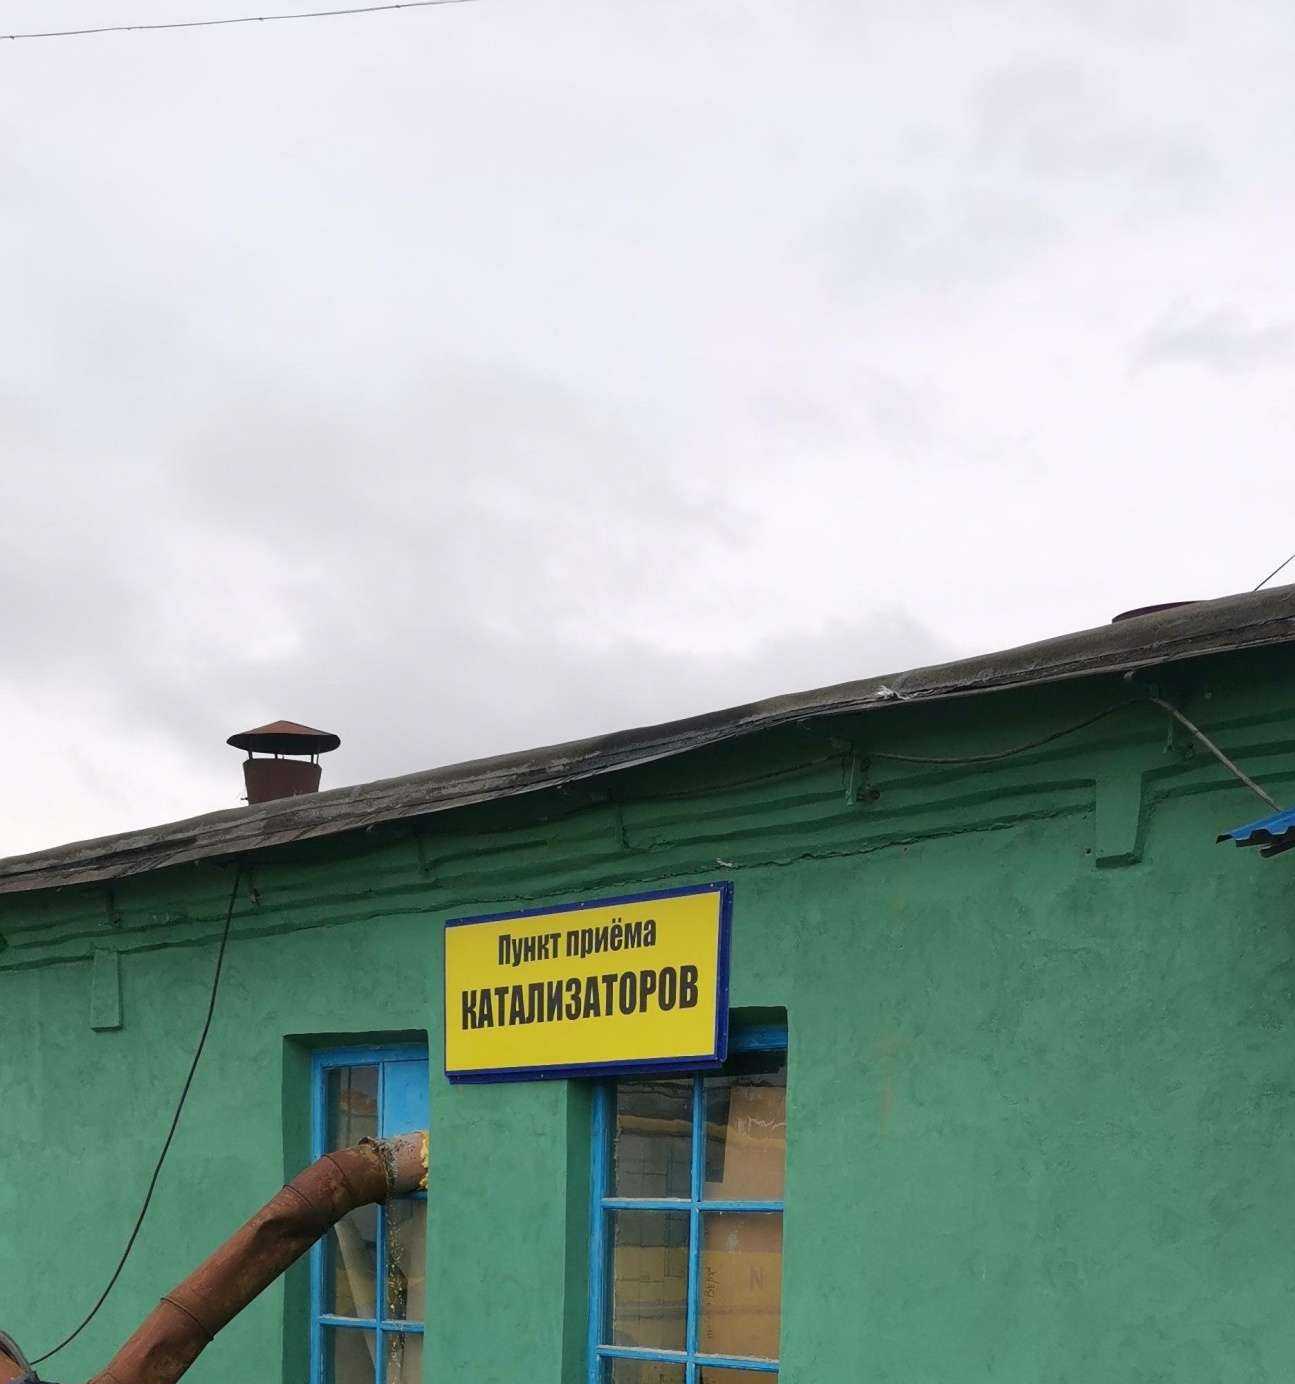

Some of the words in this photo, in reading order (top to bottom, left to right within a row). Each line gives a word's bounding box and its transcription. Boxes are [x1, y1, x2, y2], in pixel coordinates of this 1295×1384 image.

[498, 932, 561, 967] Пункт
[566, 918, 657, 958] приёма
[461, 965, 699, 1030] КАТАЛИЗАТОРОВ
